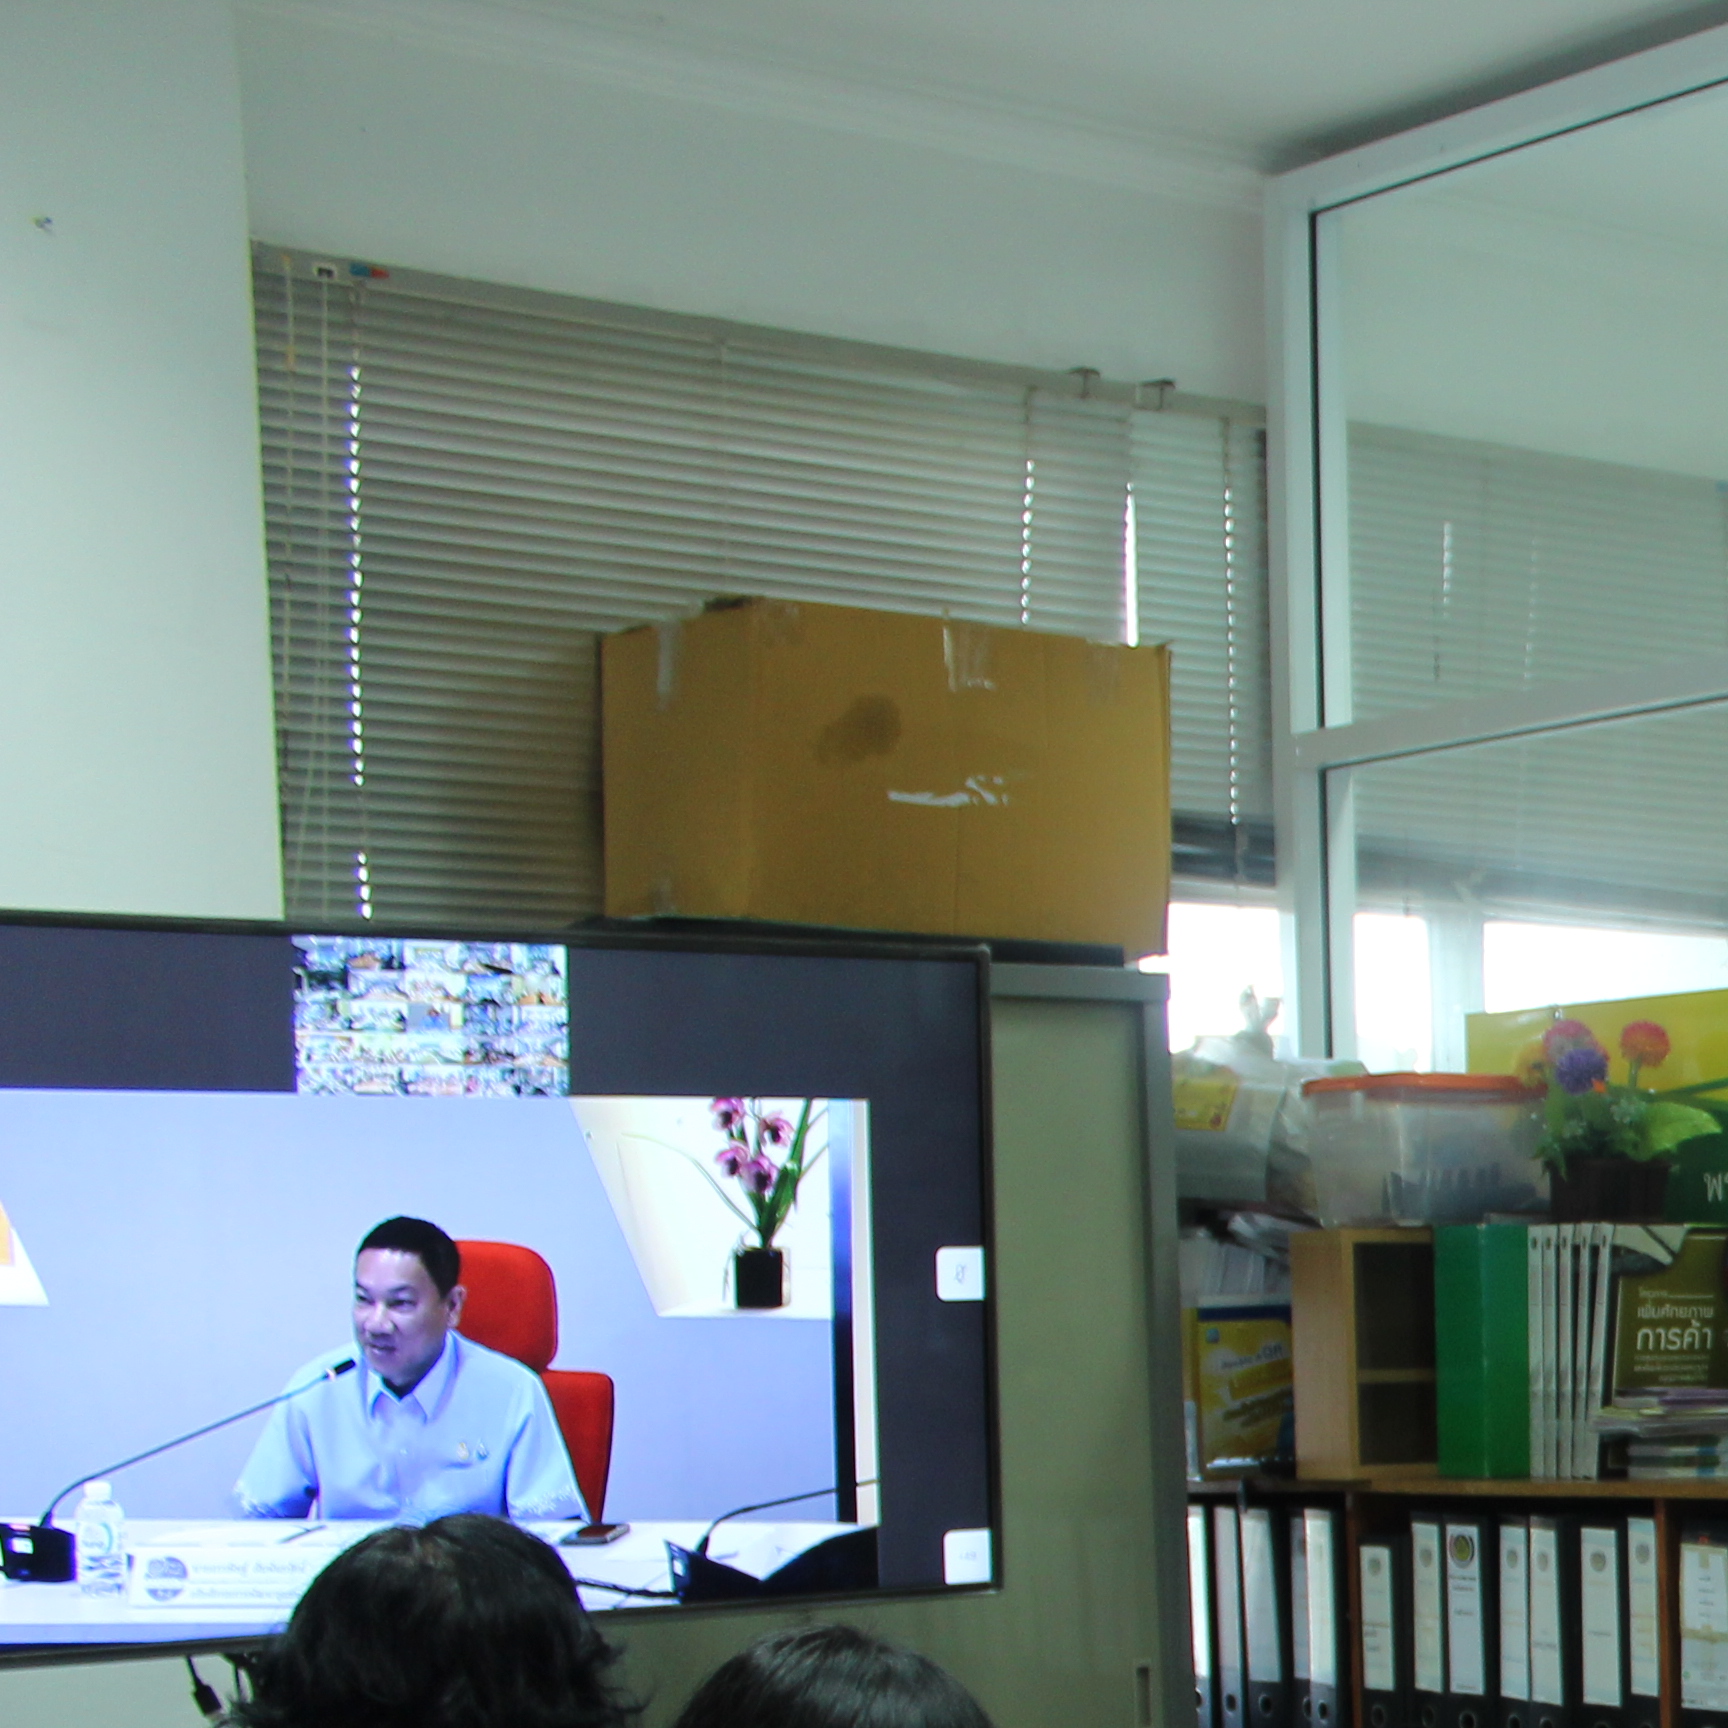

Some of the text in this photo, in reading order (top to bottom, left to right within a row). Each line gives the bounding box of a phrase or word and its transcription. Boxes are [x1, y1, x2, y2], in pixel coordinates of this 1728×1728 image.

[1637, 1299, 1714, 1319] เพิ่มศักยภาพ
[1636, 1318, 1713, 1351] การค้า
